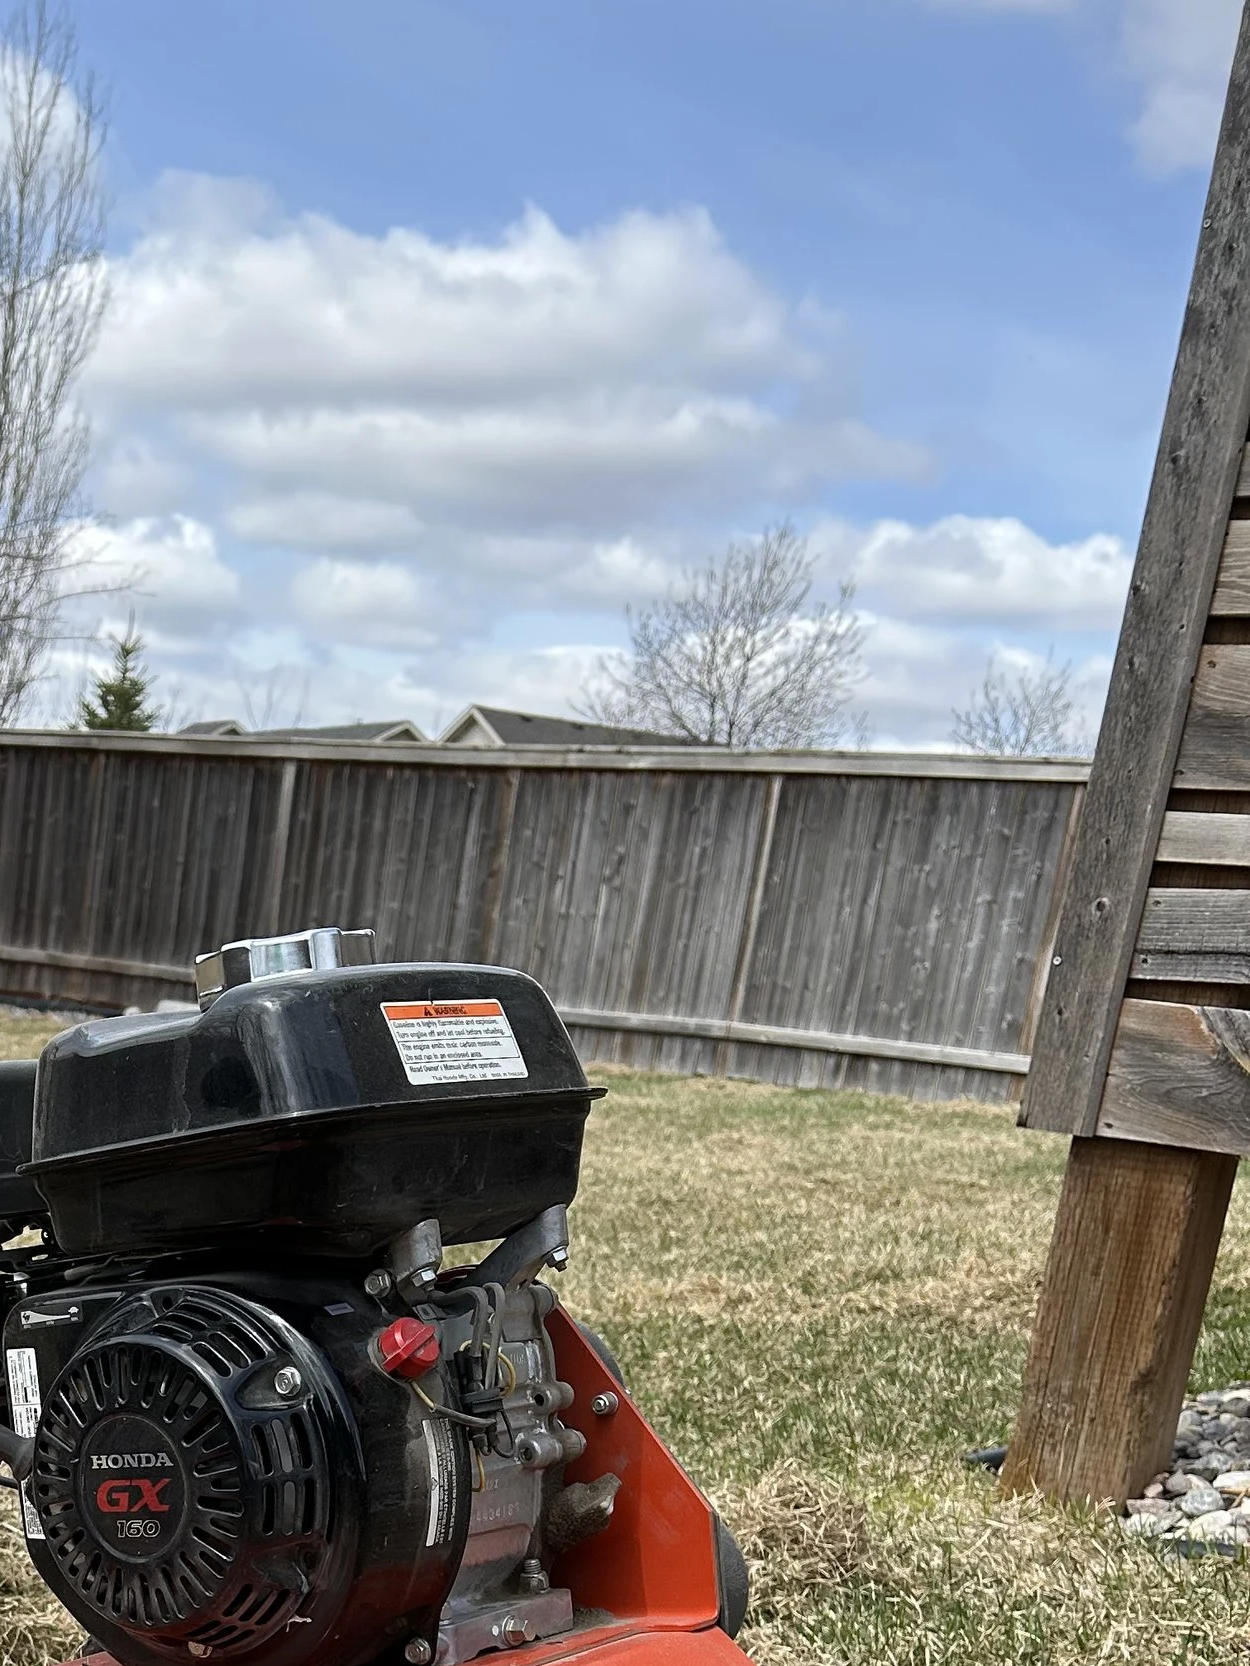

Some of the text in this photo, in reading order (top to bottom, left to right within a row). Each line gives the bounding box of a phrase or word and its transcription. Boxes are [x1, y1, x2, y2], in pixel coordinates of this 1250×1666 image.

[433, 1006, 467, 1015] WARNING
[421, 1020, 437, 1028] highly
[465, 1018, 475, 1026] and
[396, 1031, 409, 1039] Turn
[410, 1031, 427, 1039] engine
[428, 1029, 436, 1037] off
[437, 1029, 446, 1037] and
[454, 1028, 466, 1036] cool
[401, 1043, 412, 1051] The
[413, 1043, 430, 1051] engine
[459, 1040, 477, 1048] carbon
[405, 1053, 413, 1061] Do
[414, 1053, 423, 1061] not
[409, 1065, 423, 1073] Read
[443, 1063, 462, 1071] Manual
[462, 1062, 478, 1070] before
[90, 1452, 174, 1469] HONDA
[96, 1478, 172, 1513] GX
[116, 1519, 161, 1538] 160
